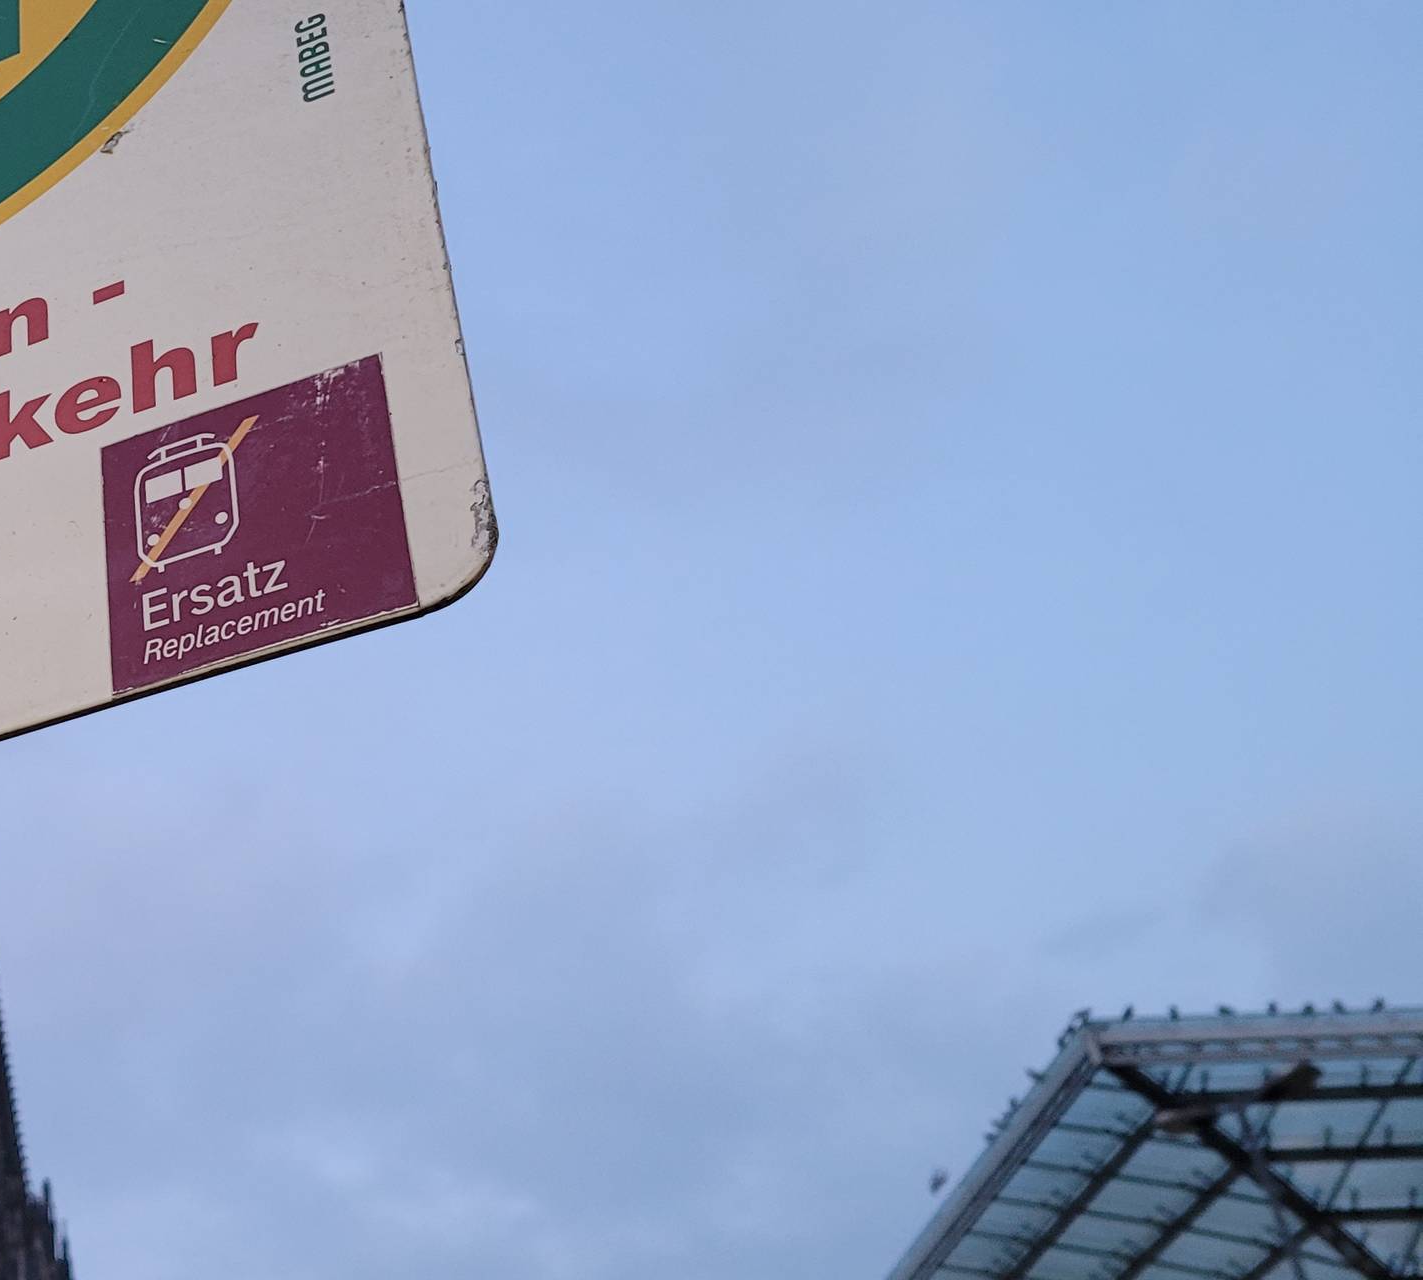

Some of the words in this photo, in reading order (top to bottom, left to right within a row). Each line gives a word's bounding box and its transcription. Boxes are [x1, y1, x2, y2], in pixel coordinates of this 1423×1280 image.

[294, 13, 335, 102] MABEG
[142, 560, 288, 632] Ersatz
[143, 589, 326, 665] Replacement
